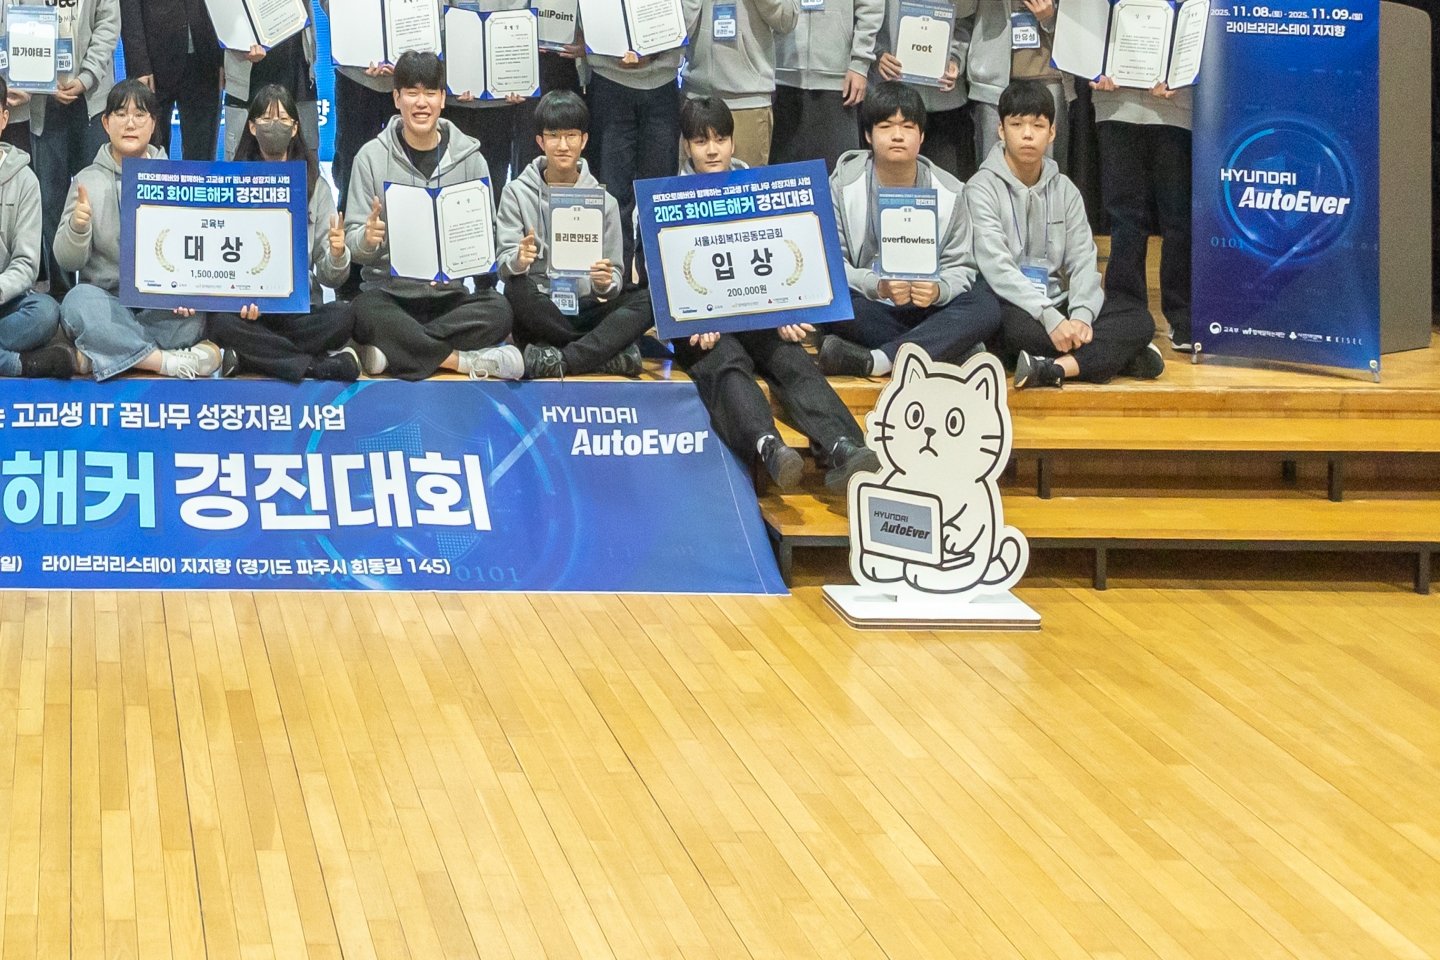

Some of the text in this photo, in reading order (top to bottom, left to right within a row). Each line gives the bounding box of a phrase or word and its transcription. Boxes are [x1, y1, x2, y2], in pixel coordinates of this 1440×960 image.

[538, 9, 574, 21] ullPoint
[1227, 22, 1345, 37] 라이브러리스테이 지지향
[911, 42, 933, 53] root
[1221, 168, 1296, 185] HYUNDAI
[137, 184, 290, 203] 2025 화이트해커 경진대회
[1238, 187, 1350, 215] AutoEver
[654, 205, 683, 222] 2025
[685, 196, 755, 219] 화이트해커
[756, 189, 814, 211] 경진대회
[201, 219, 225, 229] 교육부
[694, 228, 783, 247] 서울사회복지공동모금회
[882, 236, 935, 245] overflowless
[191, 270, 235, 280] 1,500,000원
[727, 285, 767, 297] 200,000원
[11, 402, 83, 428] 고교생
[90, 403, 110, 427] IT
[120, 403, 191, 430] 꿈나무
[196, 404, 292, 431] 성장지원
[298, 405, 346, 431] 사업
[542, 405, 638, 424] HYUNDAI
[570, 427, 709, 457] AutoEver
[174, 450, 492, 531] 경진대회
[874, 510, 909, 523] HYUNDAI
[880, 522, 931, 539] AutoEver
[42, 555, 176, 575] 라이브러리스테이
[181, 556, 231, 575] 지지향
[235, 557, 293, 576] (경기도
[297, 558, 347, 576] 파주시
[351, 558, 403, 575] 회동길
[407, 558, 451, 575] 145)
